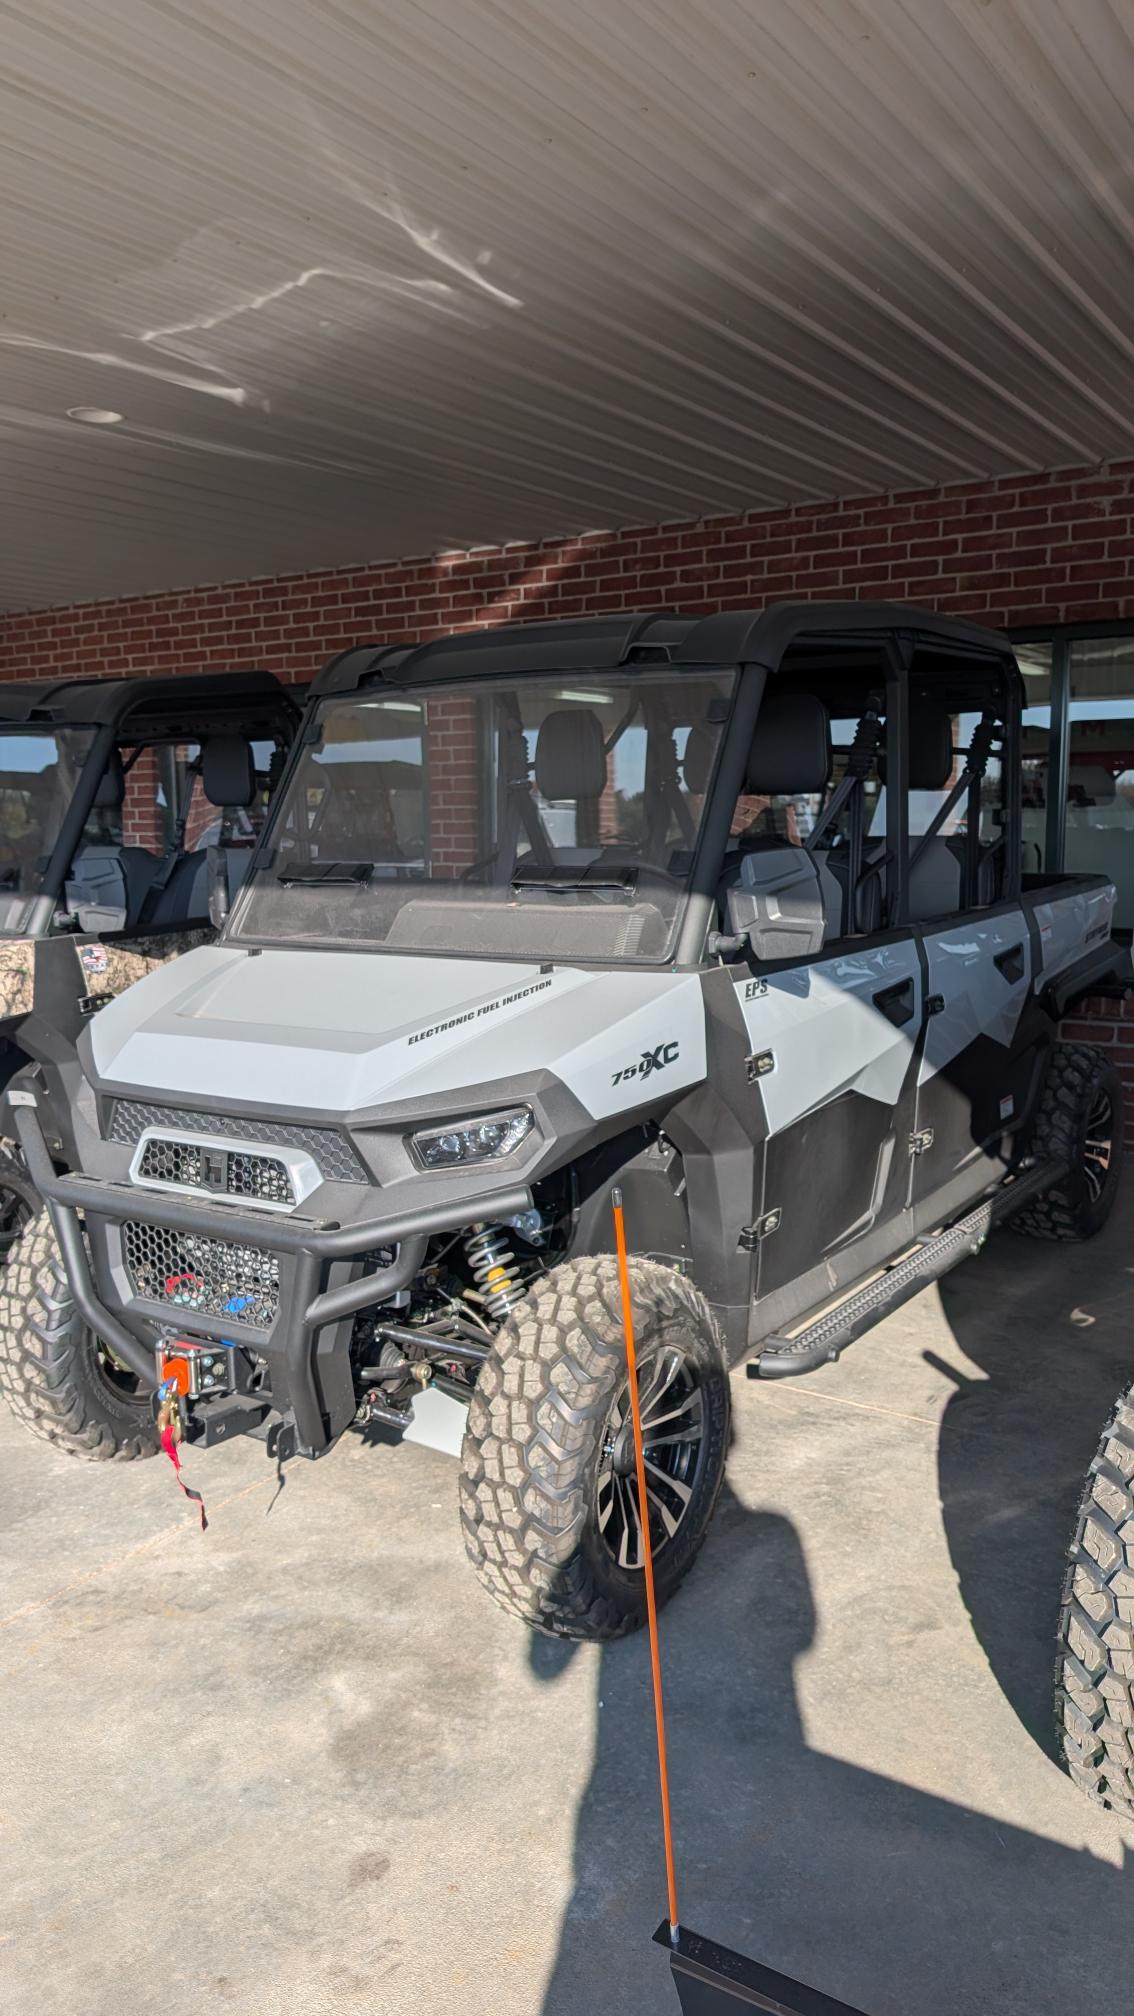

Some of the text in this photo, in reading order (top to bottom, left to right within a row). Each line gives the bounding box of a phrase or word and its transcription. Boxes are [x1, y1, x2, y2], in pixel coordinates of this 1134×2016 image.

[745, 979, 768, 998] EPS
[408, 979, 552, 1046] ELECTRONIC FUEL INJECTION
